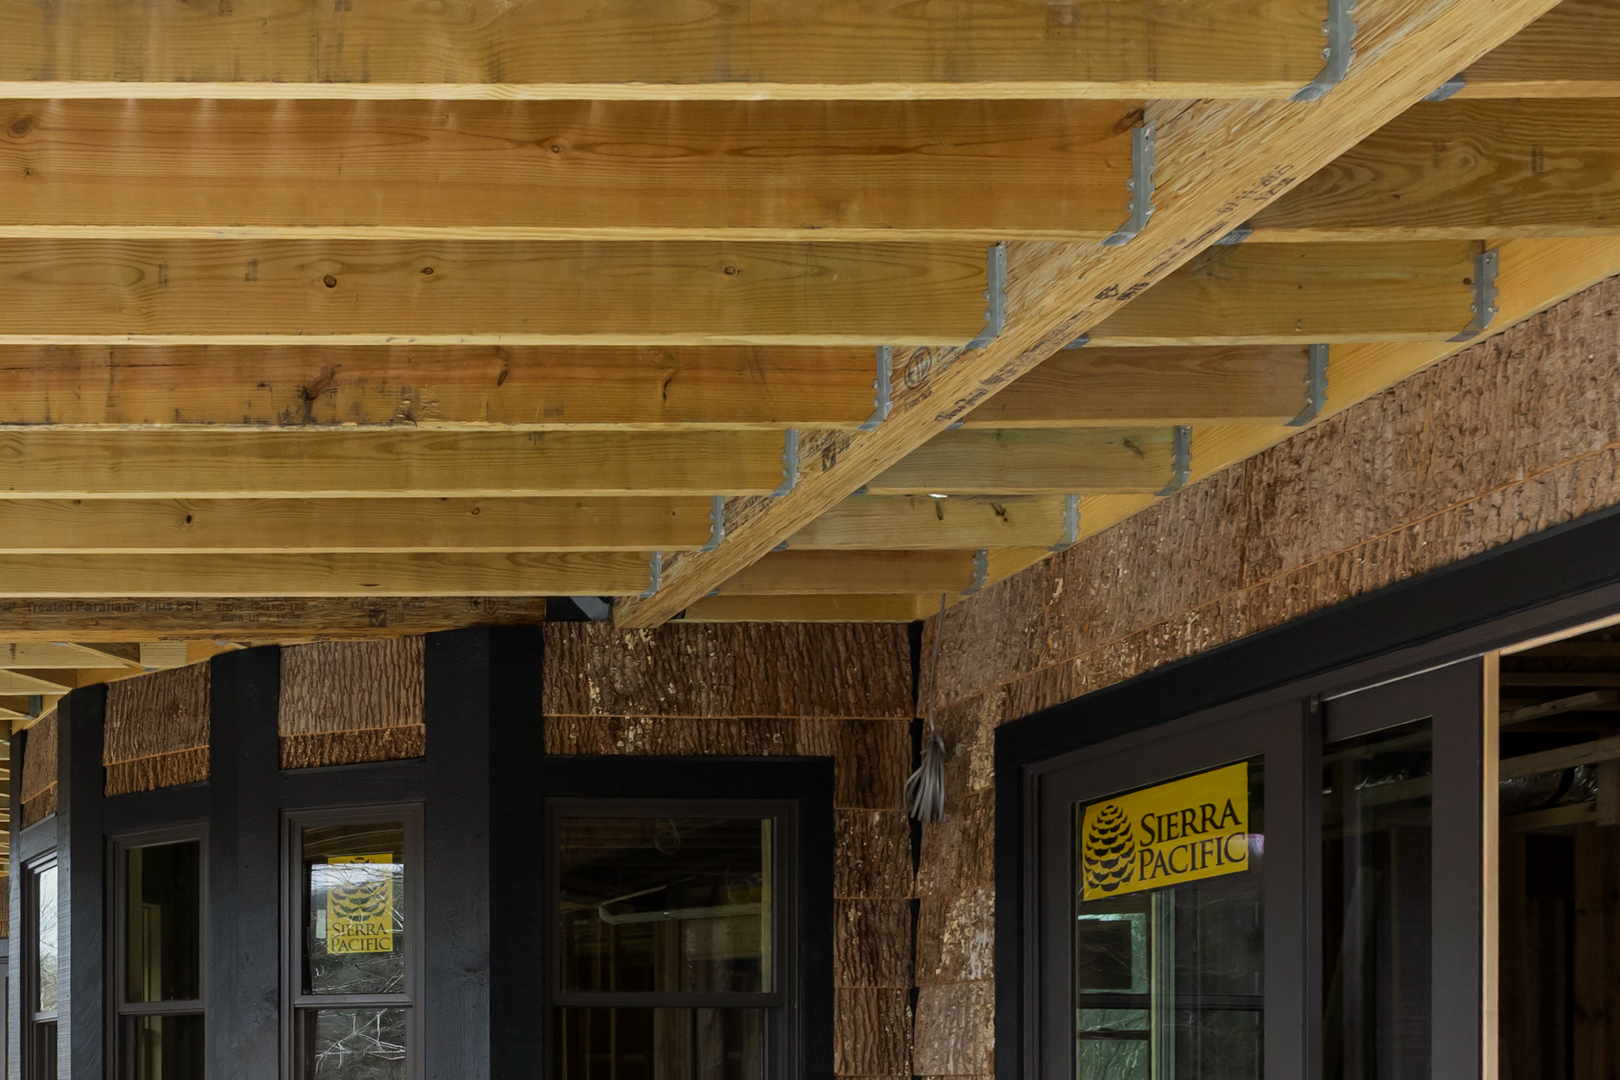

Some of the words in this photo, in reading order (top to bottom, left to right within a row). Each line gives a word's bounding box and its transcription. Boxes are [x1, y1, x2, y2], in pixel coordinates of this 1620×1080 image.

[26, 600, 73, 612] Treated
[146, 600, 172, 611] Plus
[1139, 798, 1243, 848] SIERRA
[1138, 831, 1247, 881] PACIFIC
[331, 922, 387, 936] SIERRA
[330, 936, 391, 952] PACIFIC
